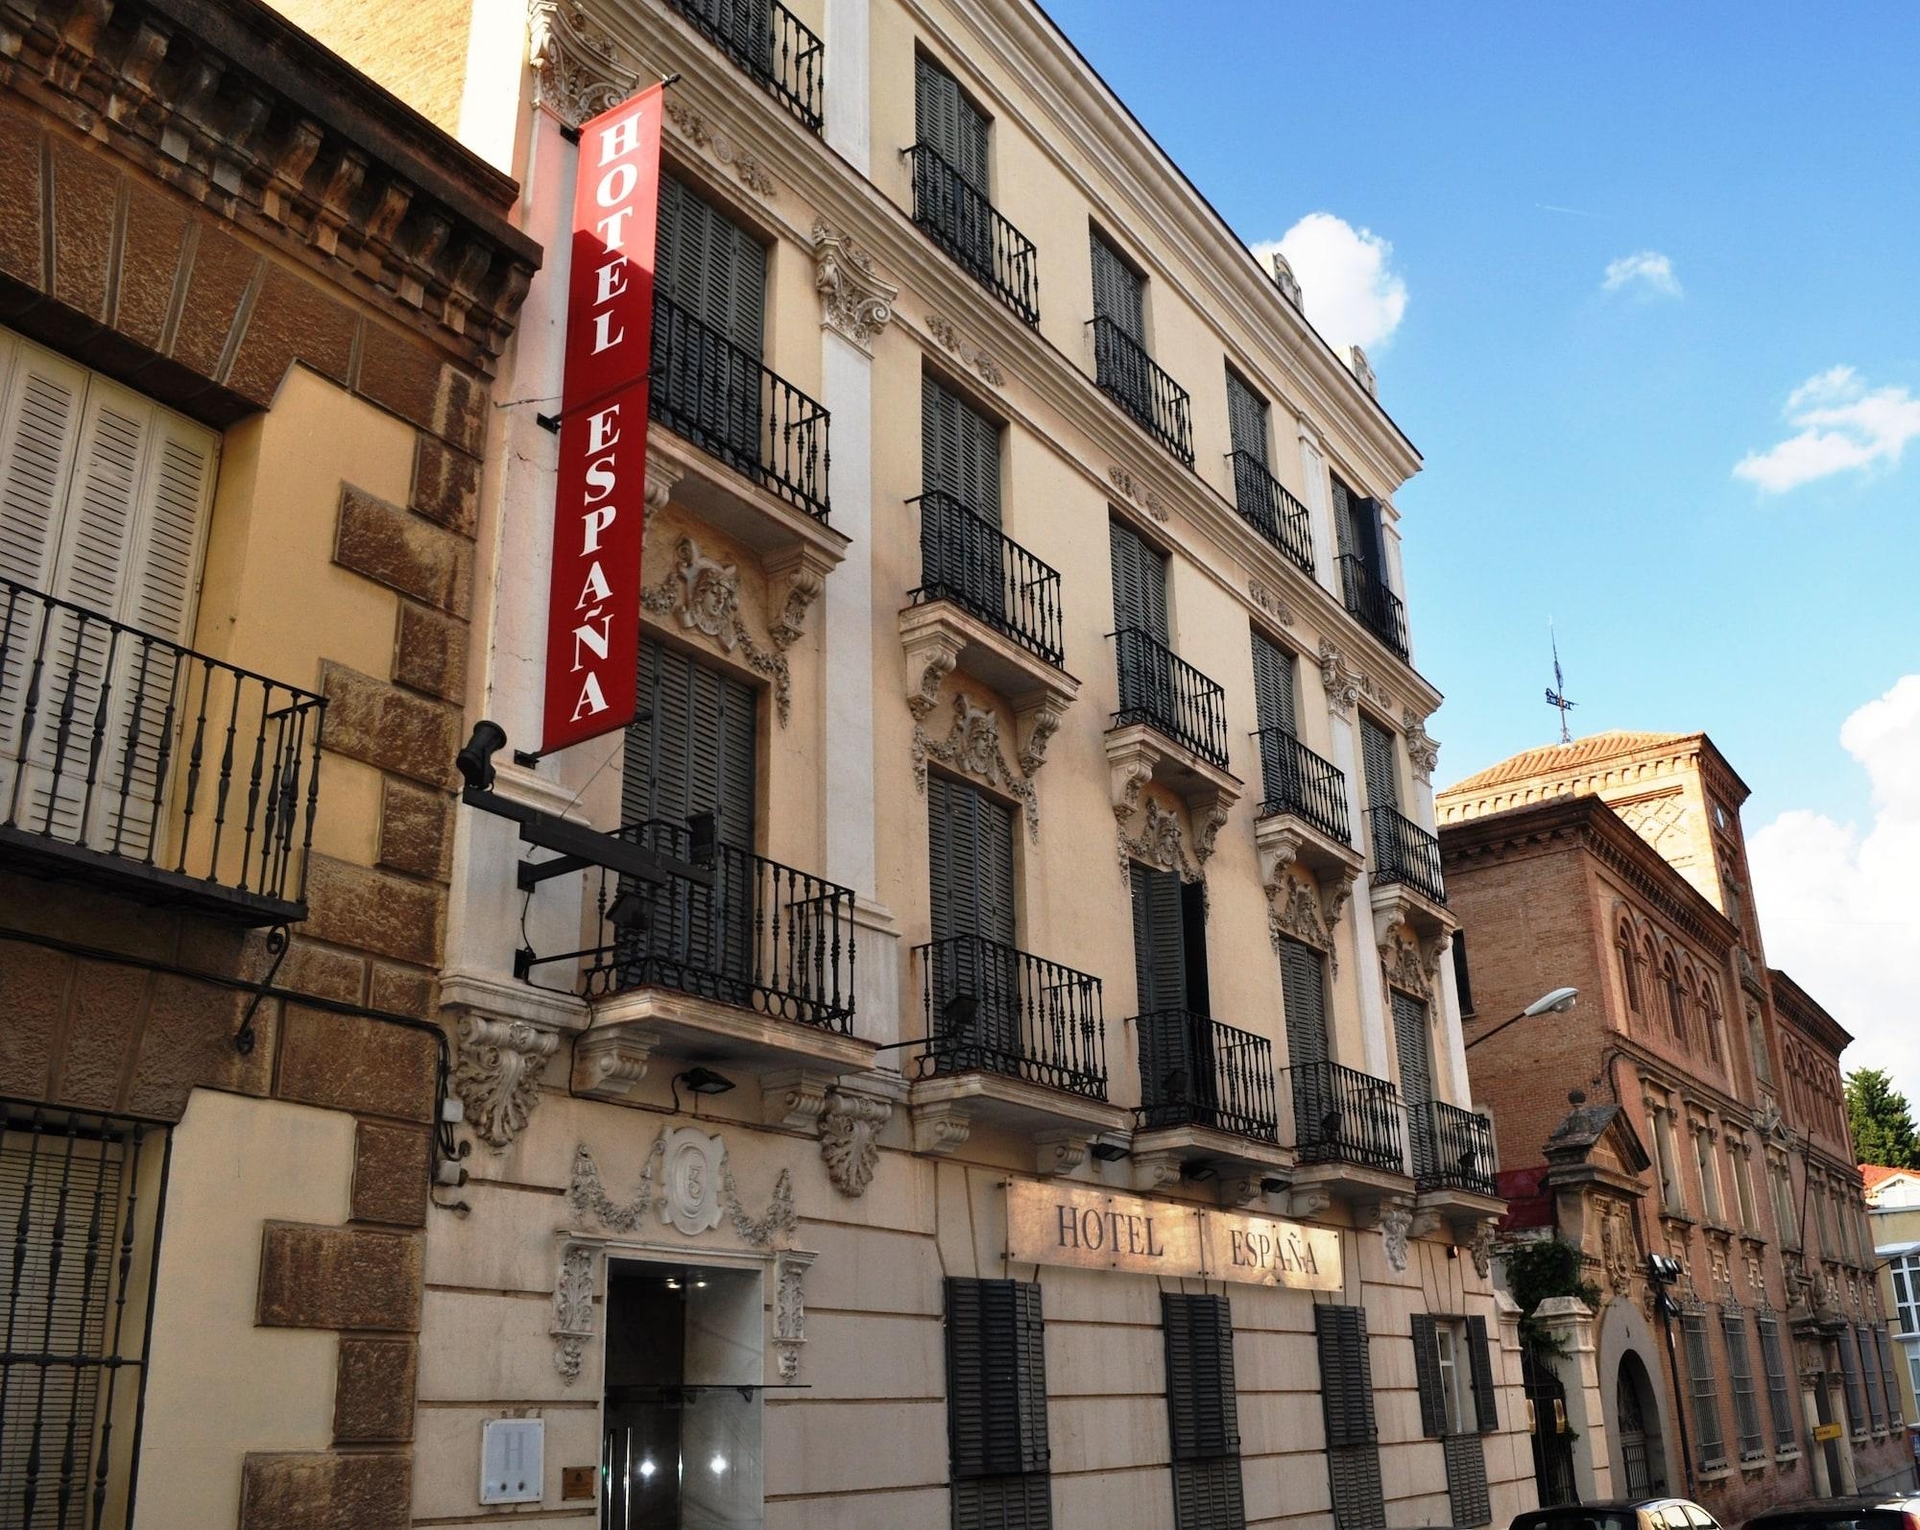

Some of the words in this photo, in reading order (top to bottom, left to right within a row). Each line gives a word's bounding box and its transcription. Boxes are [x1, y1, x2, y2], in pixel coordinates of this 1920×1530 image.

[590, 111, 643, 356] HOTEL
[569, 403, 621, 723] ESPAÑA
[1055, 1204, 1164, 1258] HOTEL
[1230, 1228, 1320, 1276] ESPAÑA
[503, 1431, 525, 1472] H
